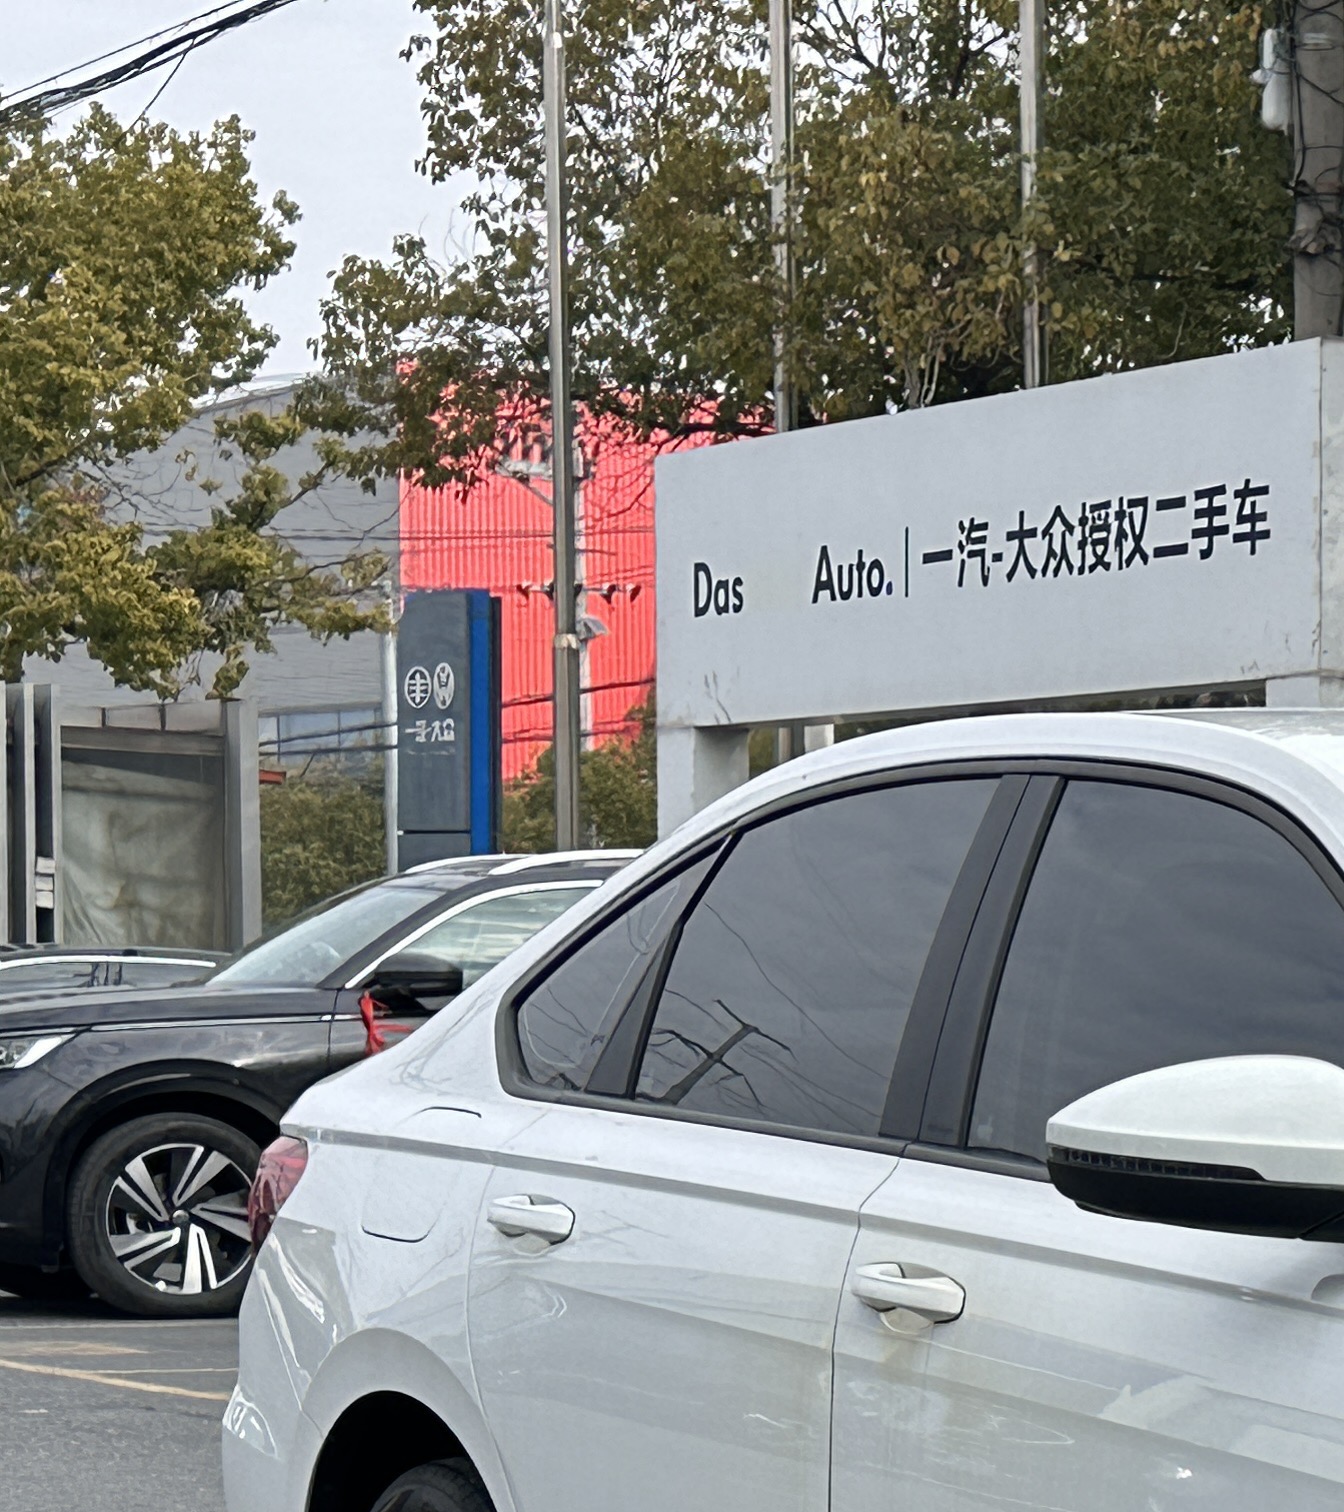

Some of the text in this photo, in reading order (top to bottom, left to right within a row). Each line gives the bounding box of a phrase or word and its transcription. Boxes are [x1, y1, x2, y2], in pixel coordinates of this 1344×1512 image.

[693, 478, 1271, 618] Das Auto. 一汽-大众授权二手车
